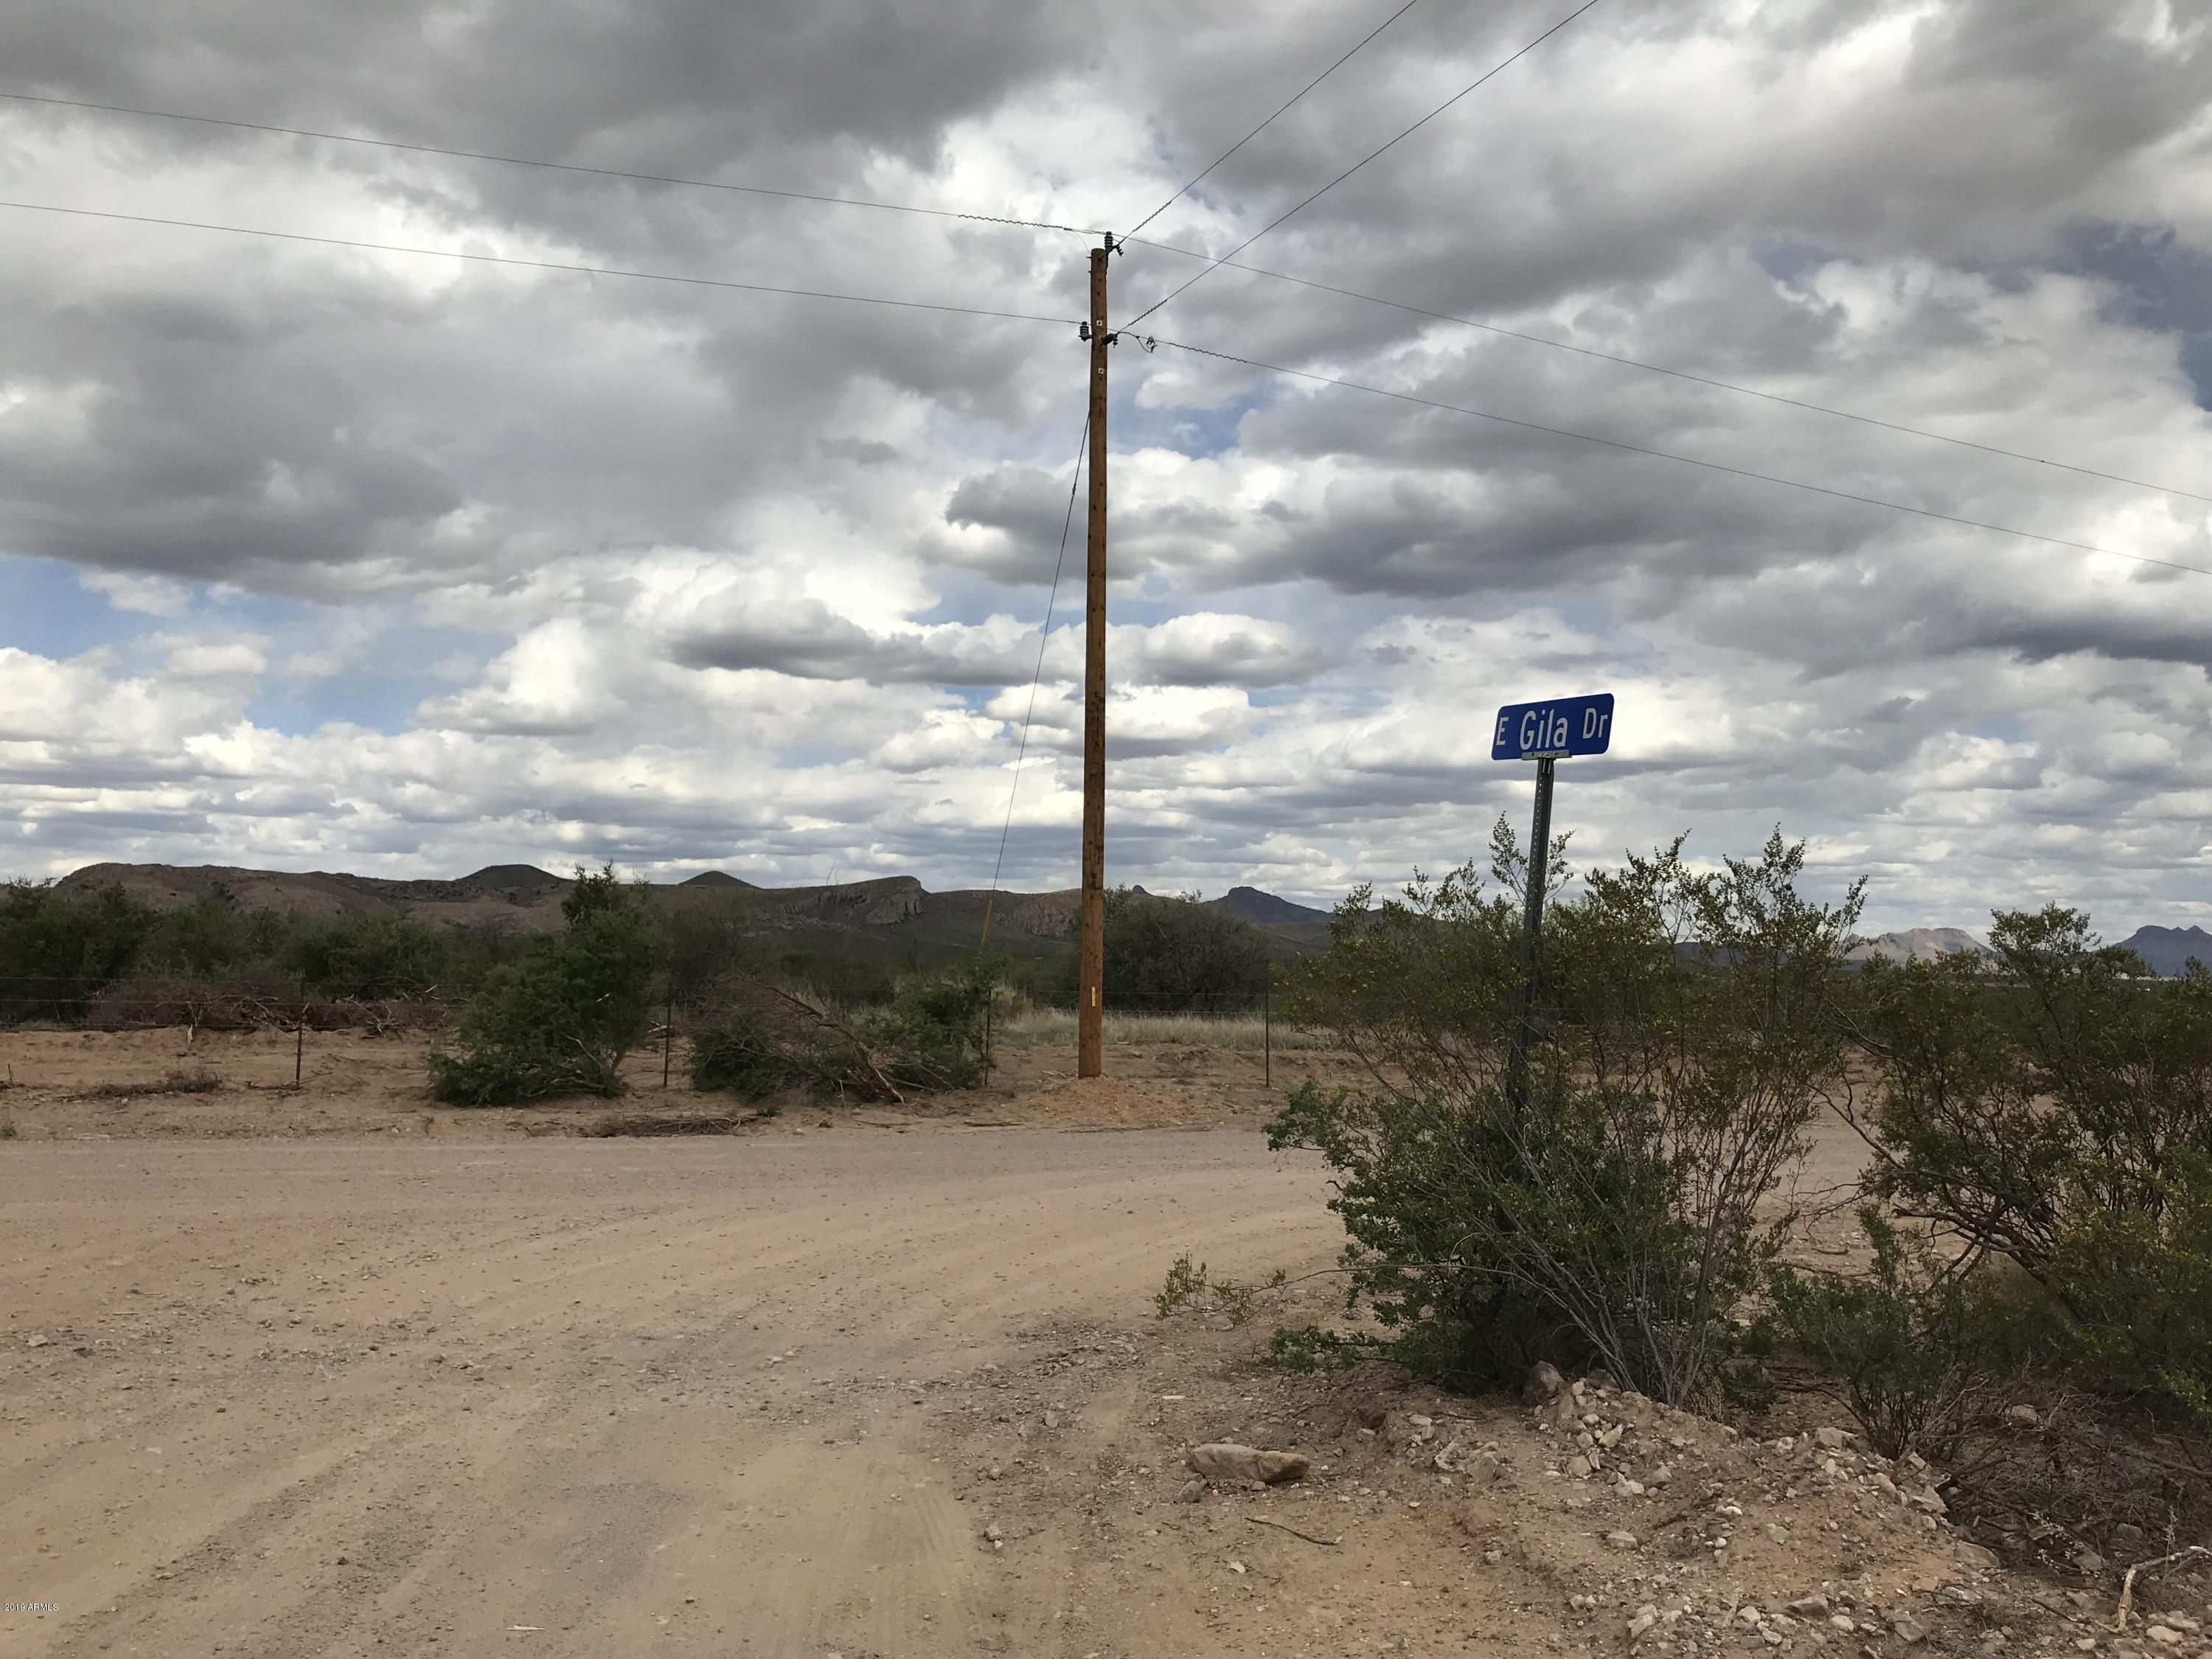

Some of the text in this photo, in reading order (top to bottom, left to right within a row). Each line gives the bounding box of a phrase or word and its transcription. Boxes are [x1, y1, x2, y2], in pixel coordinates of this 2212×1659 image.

[1496, 708, 1608, 750] E Gila Dr
